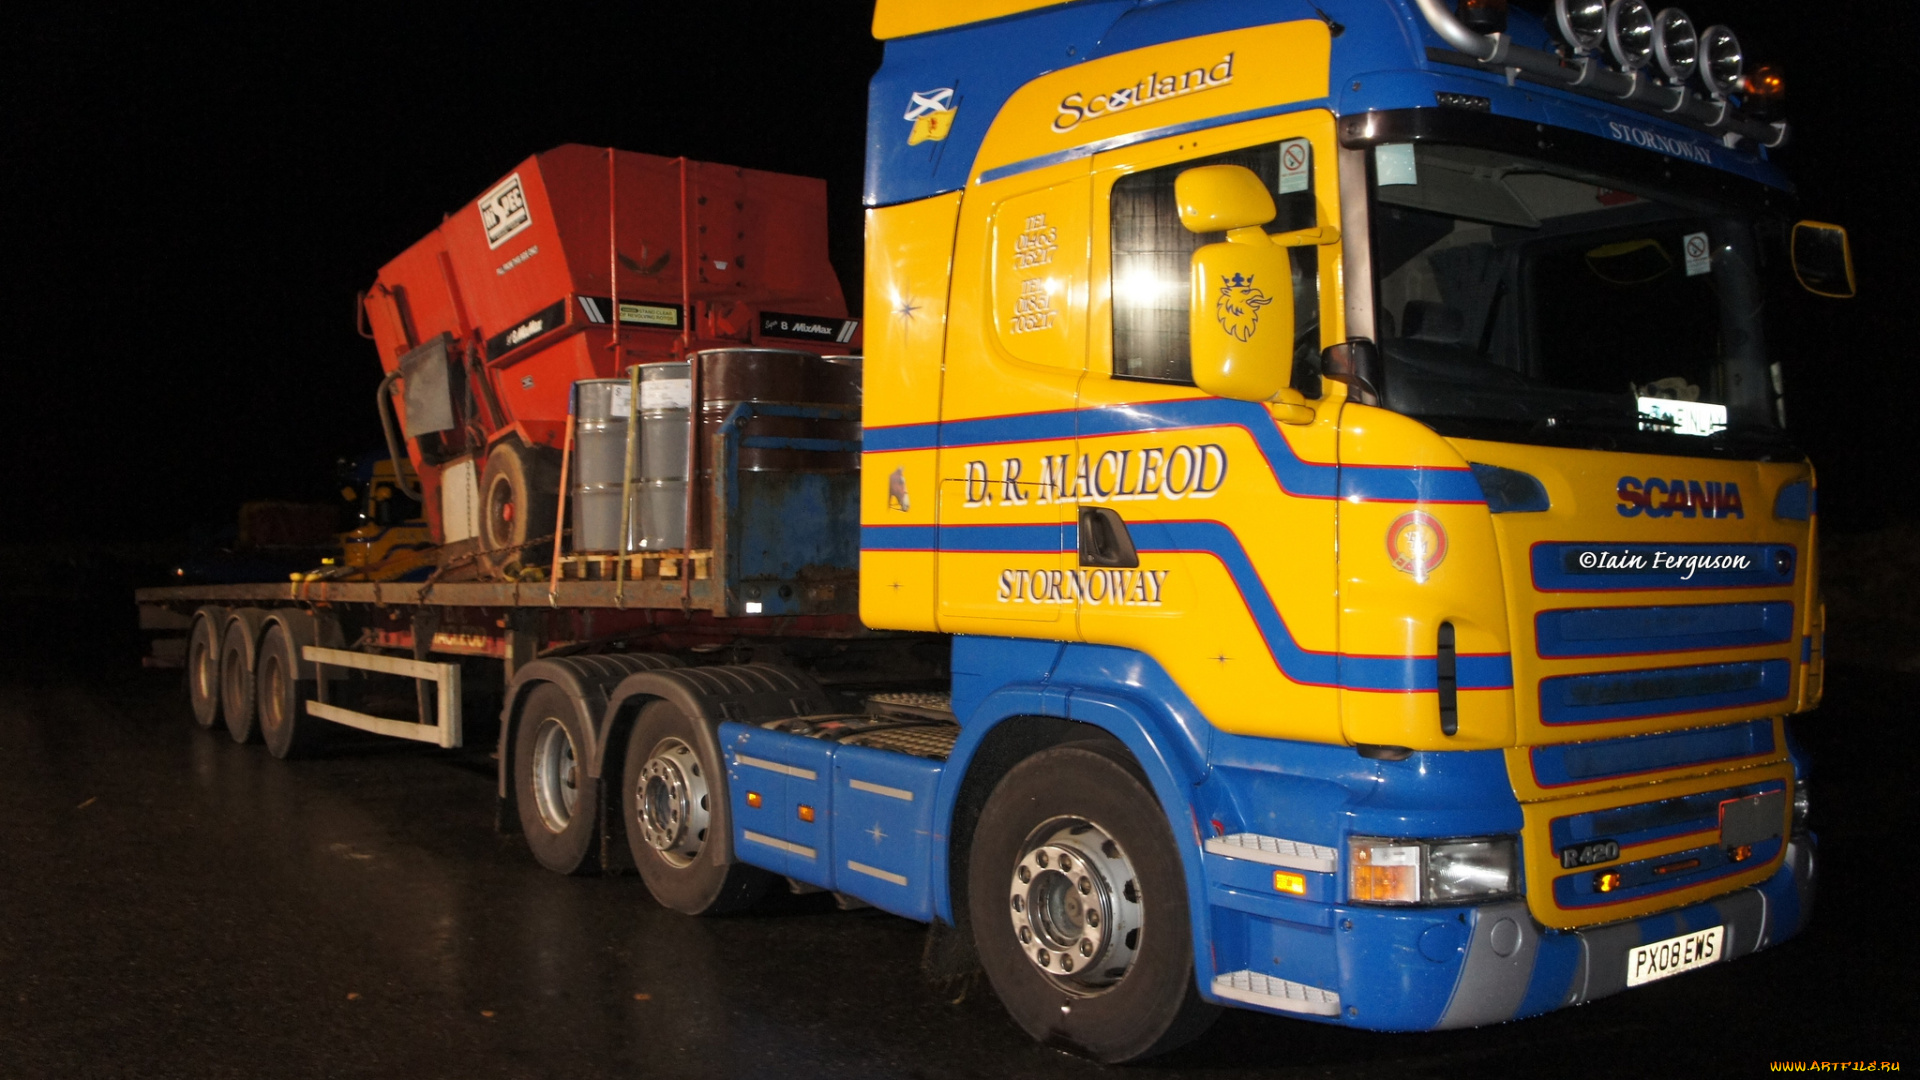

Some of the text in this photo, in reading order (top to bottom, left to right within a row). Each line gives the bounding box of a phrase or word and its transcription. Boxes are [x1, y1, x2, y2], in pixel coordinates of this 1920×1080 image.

[1051, 51, 1235, 134] Scotland
[1609, 121, 1712, 164] STORNOWAY
[792, 323, 832, 335] MixMax
[963, 443, 1228, 508] D. R. MACLEOD
[1615, 476, 1744, 519] SCANIA
[997, 569, 1170, 607] STORNOWAY
[1564, 842, 1619, 868] R 420
[1636, 932, 1715, 978] PX08 EWS
